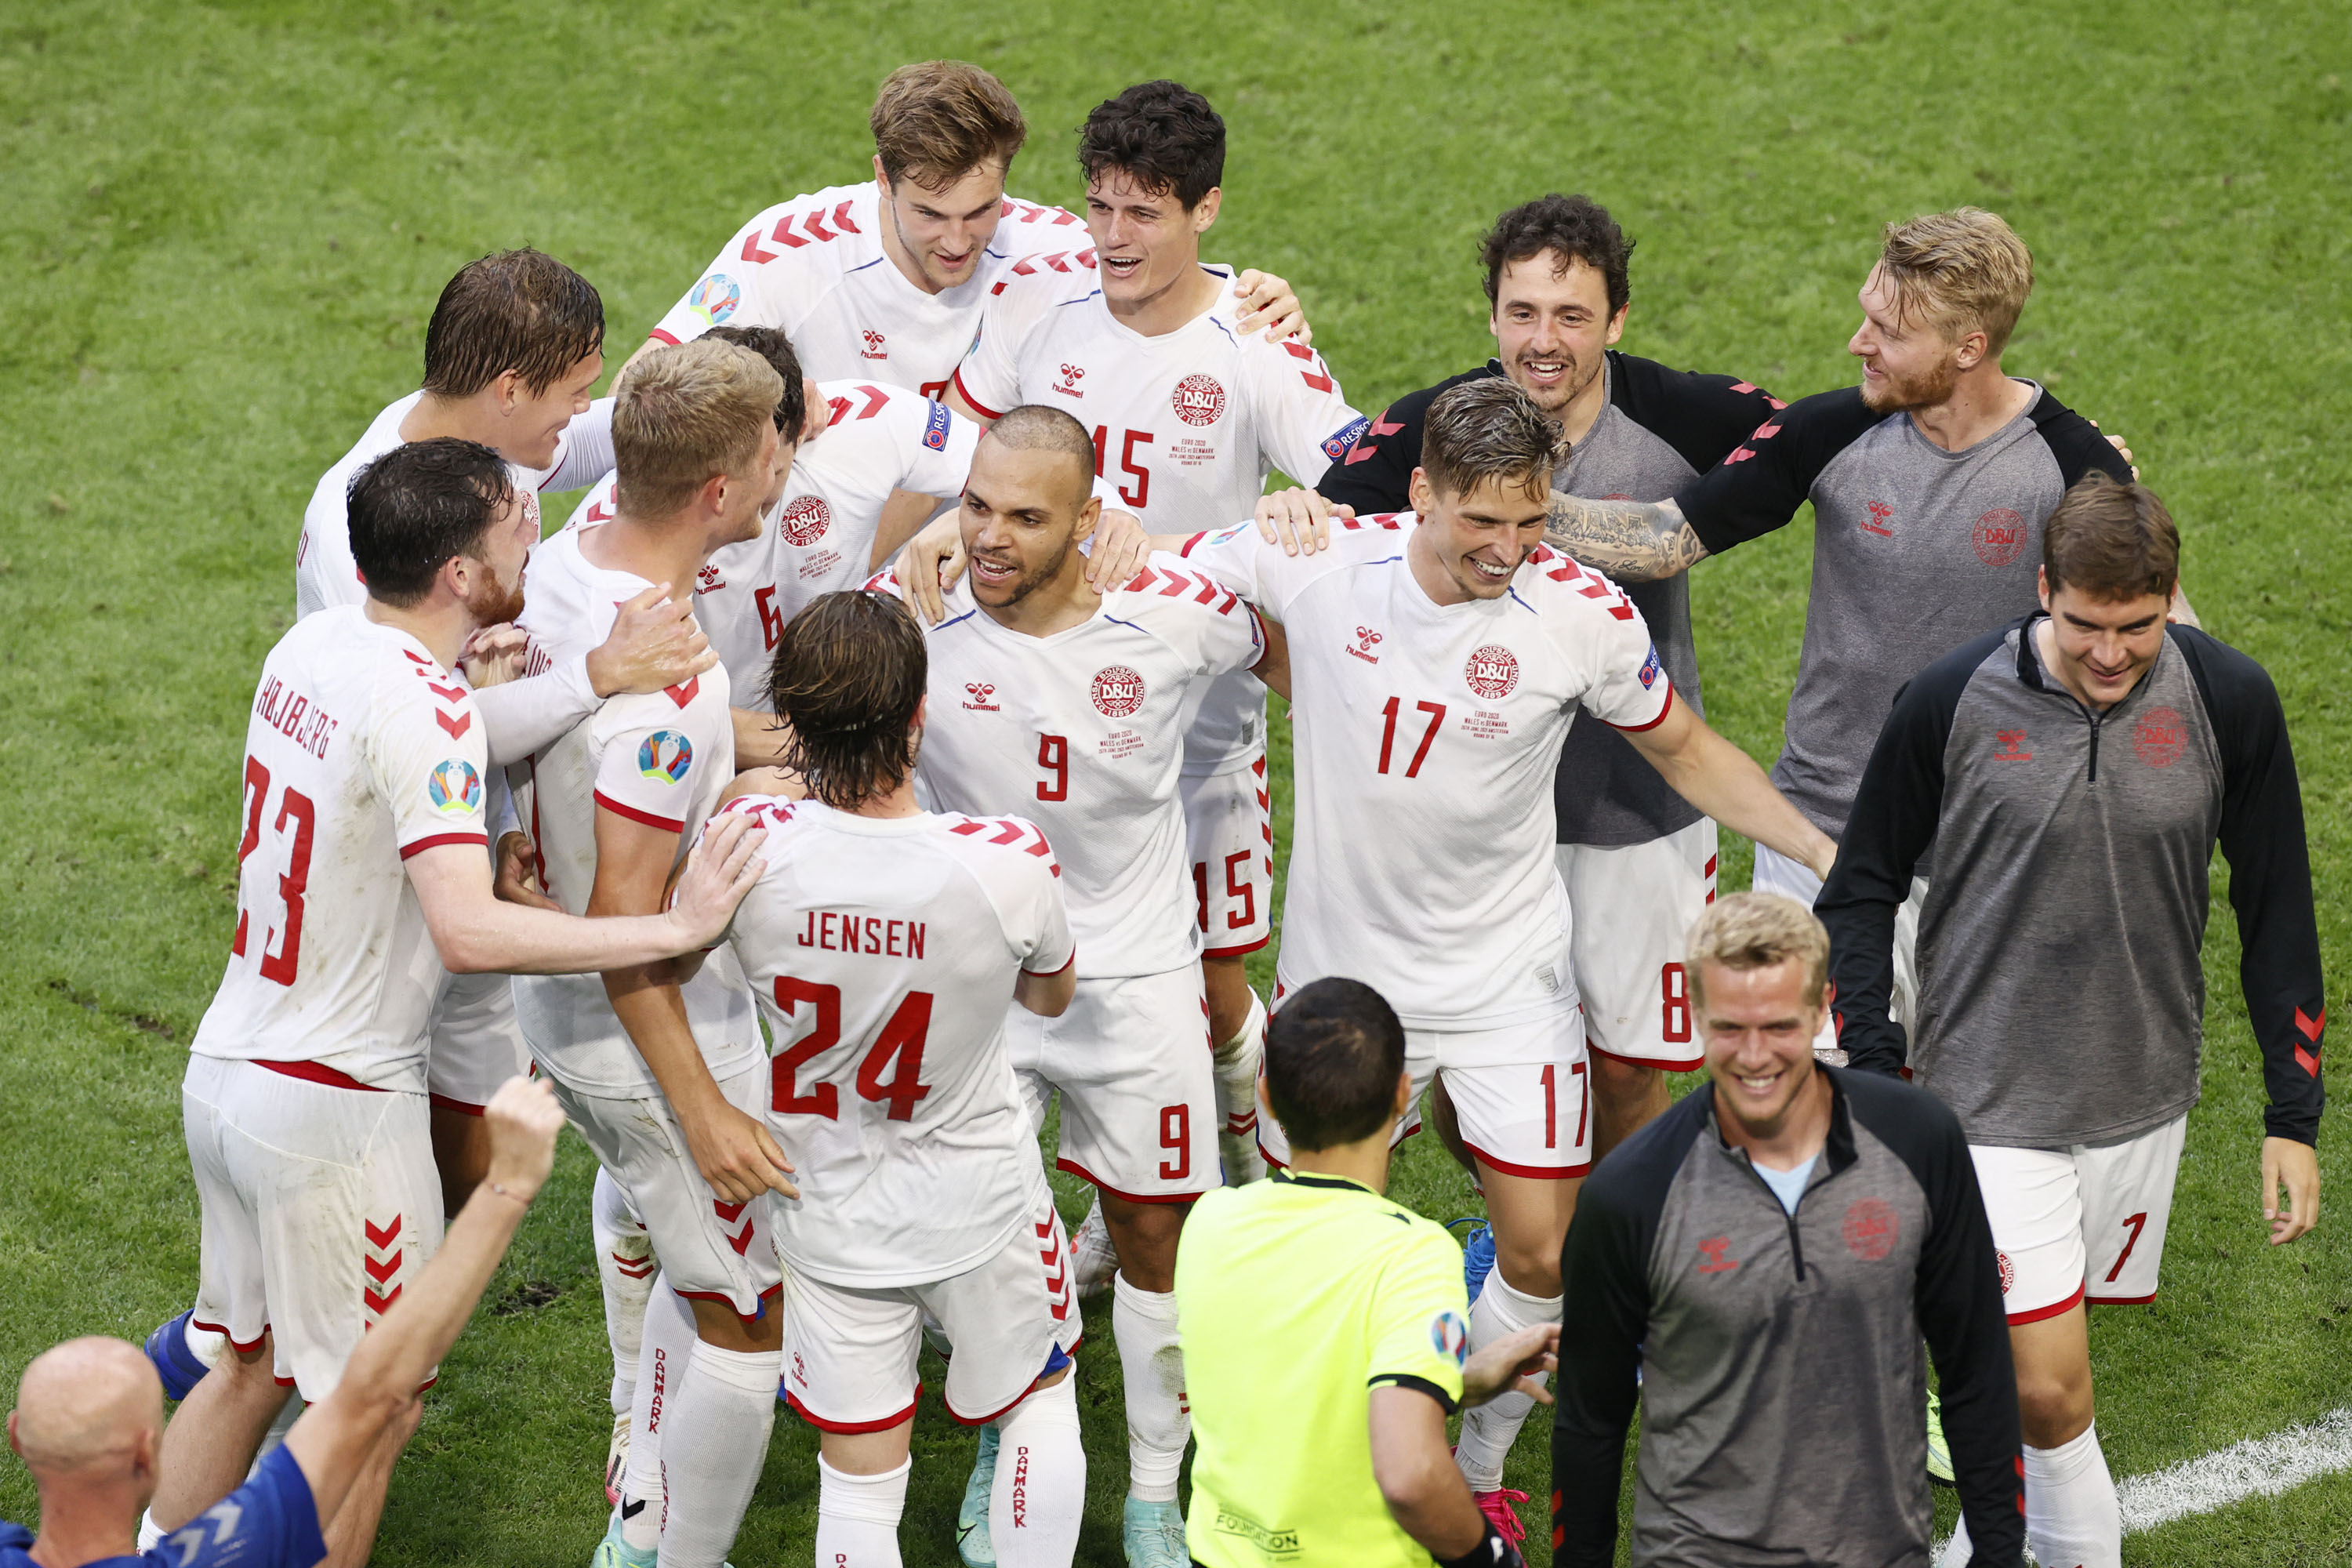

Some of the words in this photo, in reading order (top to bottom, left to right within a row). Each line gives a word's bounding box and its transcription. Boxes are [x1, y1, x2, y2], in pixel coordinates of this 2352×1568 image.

[861, 350, 887, 360] hummel
[1052, 382, 1083, 399] hummel
[1182, 391, 1215, 408] DBU
[1091, 425, 1154, 509] 15
[789, 508, 821, 533] DBU
[1860, 521, 1893, 538] hummel
[1985, 528, 2016, 545] DBU
[799, 564, 813, 573] WALES
[818, 552, 839, 564] DENMARK
[805, 554, 817, 563] EURO
[695, 580, 726, 596] hummel
[754, 581, 785, 653] 6
[1345, 644, 1379, 665] hummel
[1475, 662, 1509, 681] DBU
[1102, 684, 1134, 699] DBU
[963, 700, 1000, 712] hummel
[1465, 717, 1479, 726] WALES
[1486, 720, 1508, 728] DENMARK
[1121, 735, 1142, 746] DENMARK
[1377, 695, 1447, 779] 17
[1036, 733, 1068, 802] 9
[232, 754, 315, 987] 23
[1192, 849, 1255, 933] 15
[797, 911, 926, 960] JENSEN
[1662, 962, 1692, 1044] 8
[771, 975, 935, 1121] 24
[1541, 1062, 1588, 1149] 17
[1159, 1103, 1190, 1180] 9
[648, 1348, 666, 1434] DANMARK
[1013, 1446, 1029, 1528] DANMARK
